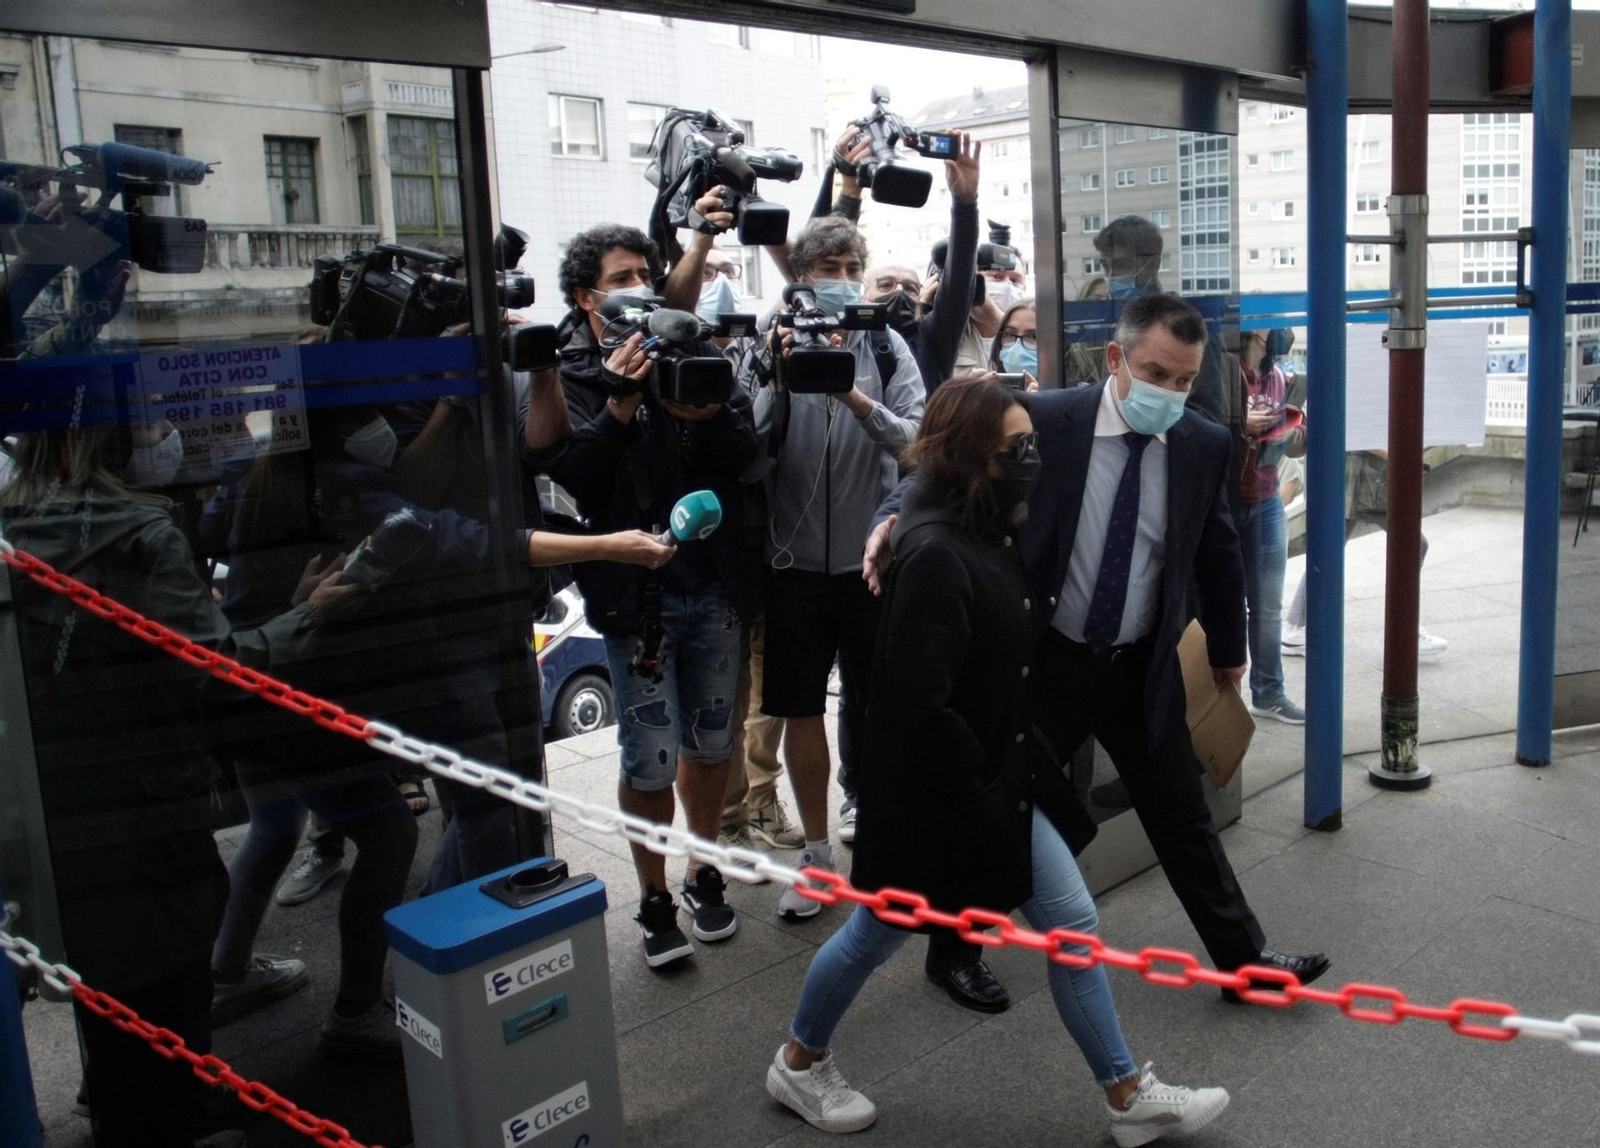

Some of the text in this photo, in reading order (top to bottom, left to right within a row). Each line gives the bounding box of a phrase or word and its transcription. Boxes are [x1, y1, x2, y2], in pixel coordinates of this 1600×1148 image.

[516, 952, 571, 986] Clece
[409, 1017, 441, 1053] Clece
[533, 1093, 587, 1130] Clece
